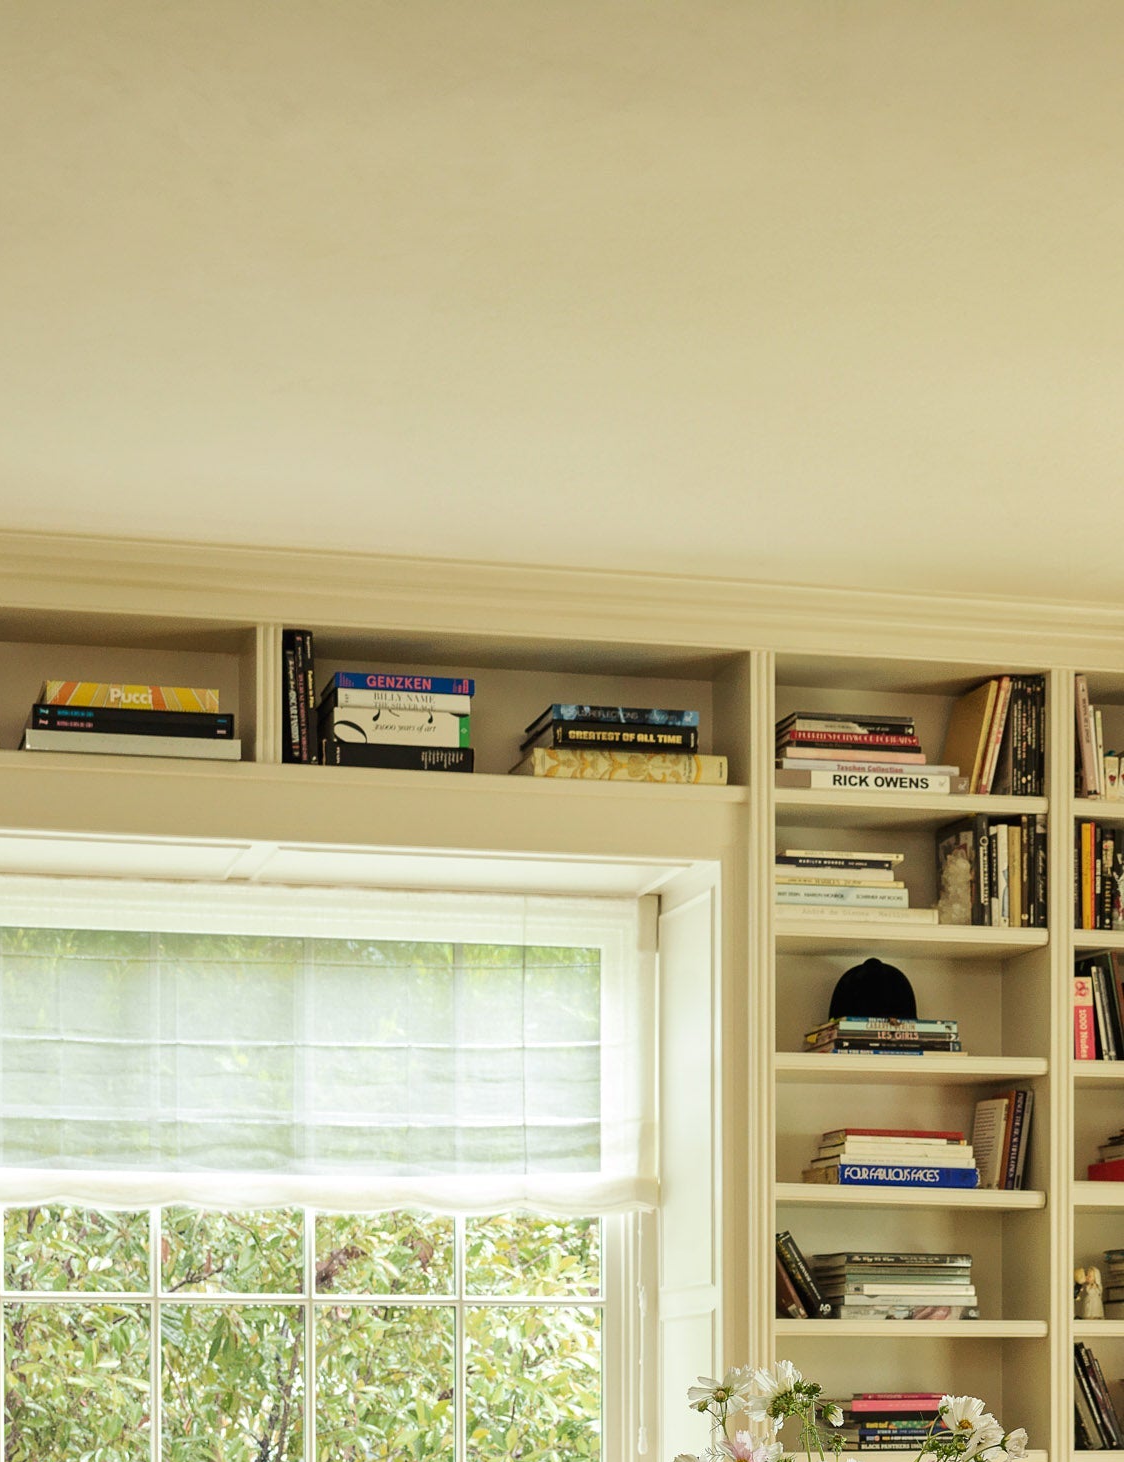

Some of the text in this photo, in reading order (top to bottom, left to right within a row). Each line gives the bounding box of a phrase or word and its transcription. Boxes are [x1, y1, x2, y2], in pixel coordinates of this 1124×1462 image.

[366, 675, 432, 690] GENZKEN
[110, 687, 153, 705] Pucci
[374, 692, 435, 704] BILLY NAME
[397, 724, 437, 733] years of art
[568, 730, 683, 744] GREATEST OF ALL TIME
[836, 764, 904, 773] Taschen Collection
[832, 774, 929, 789] RICK OWENS
[877, 1031, 919, 1040] LES GIRLS
[1078, 1008, 1089, 1059] 1000 Nudes
[844, 1167, 940, 1182] FOUR FABULOUS FACES
